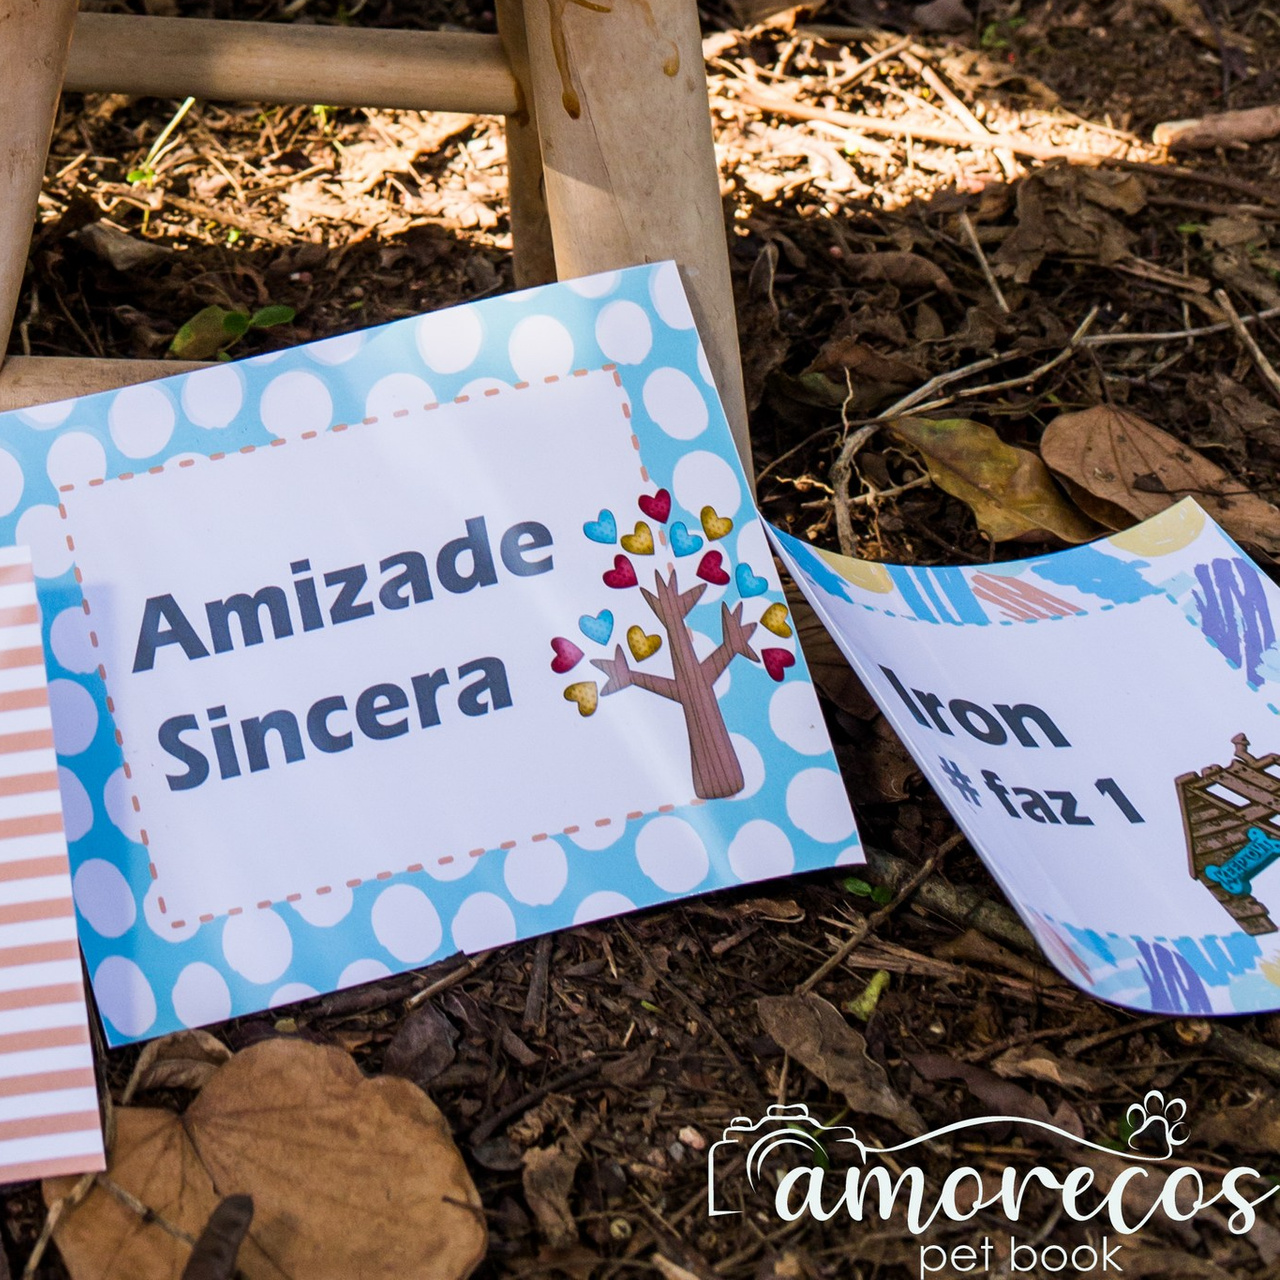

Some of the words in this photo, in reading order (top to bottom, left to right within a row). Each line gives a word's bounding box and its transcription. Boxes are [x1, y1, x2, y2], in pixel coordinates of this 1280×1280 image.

[132, 516, 554, 673] Amizade
[157, 656, 514, 792] Sincera
[878, 664, 1072, 748] Iron
[980, 769, 1095, 826] faz
[1094, 777, 1146, 824] 1
